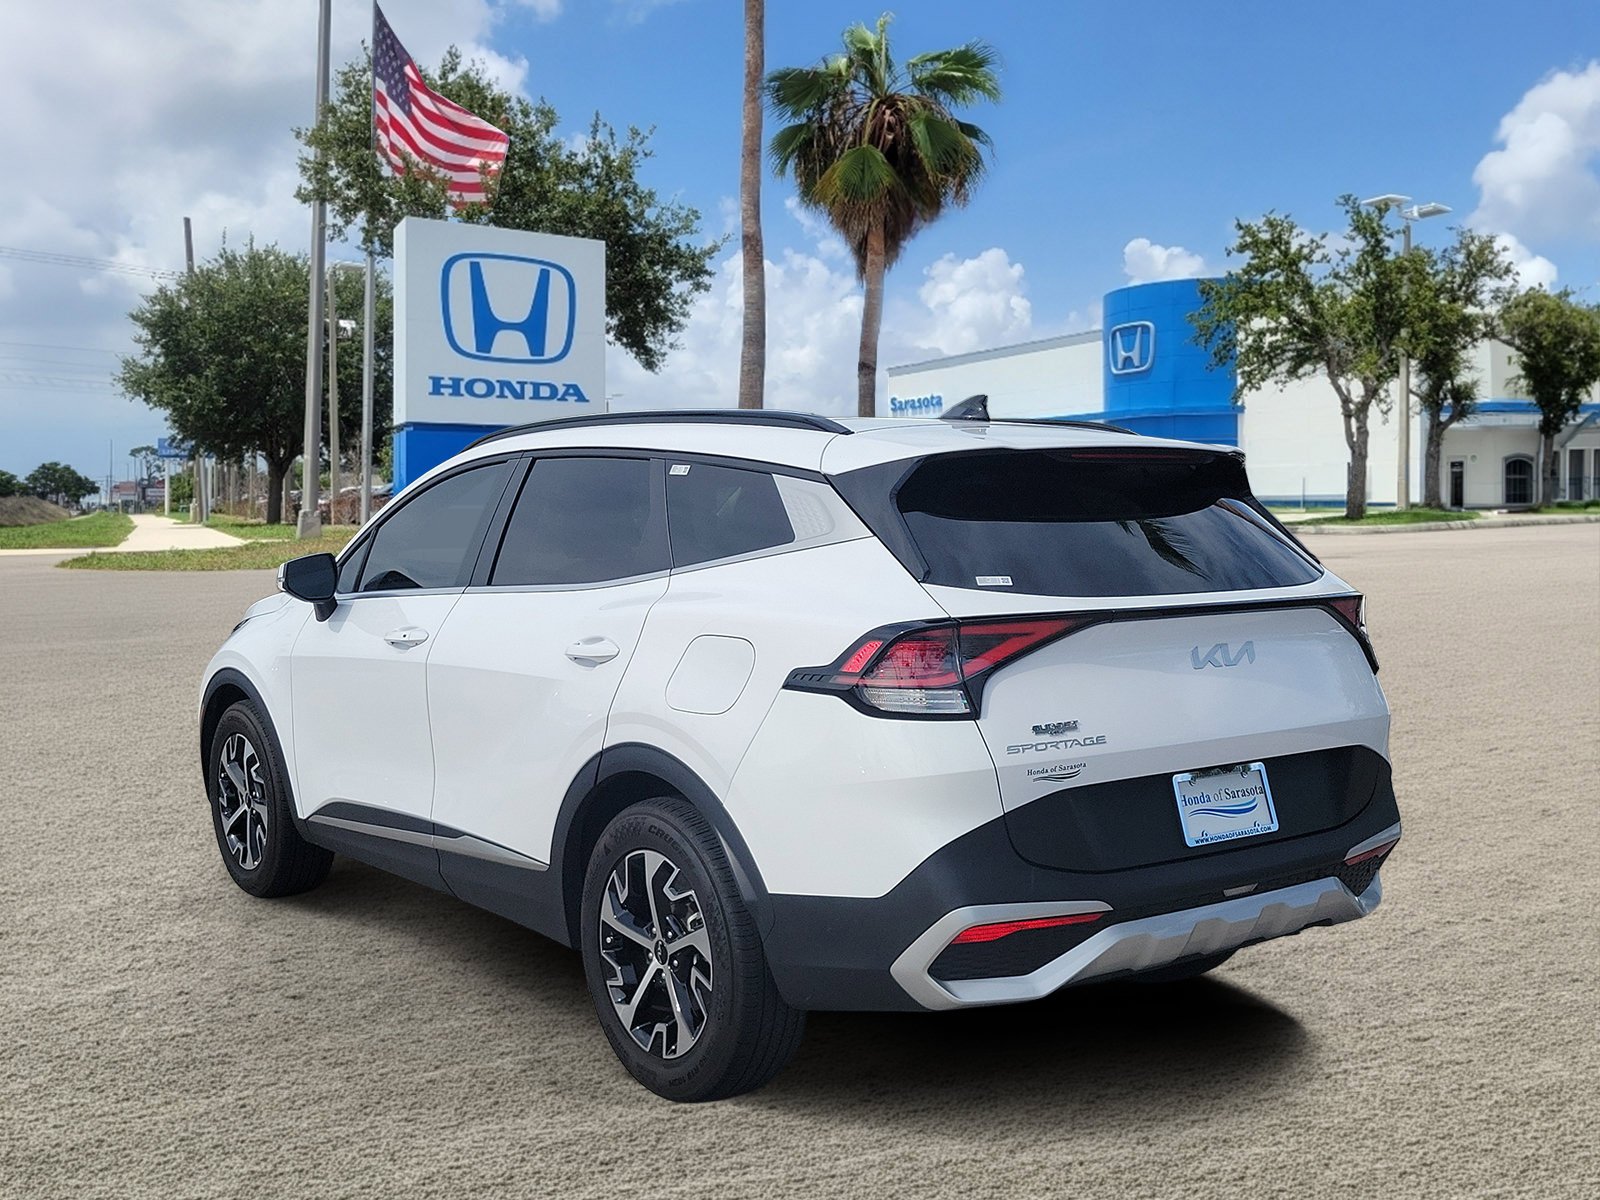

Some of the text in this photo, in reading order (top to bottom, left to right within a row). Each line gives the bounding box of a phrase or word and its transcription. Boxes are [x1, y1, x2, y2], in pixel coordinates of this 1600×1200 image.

[428, 376, 589, 402] HONDA
[890, 394, 943, 412] Sarasota
[1006, 735, 1107, 755] SPORTAGE
[1027, 761, 1087, 776] Honda of Sarasota
[1181, 785, 1265, 807] Honda of Sarasota
